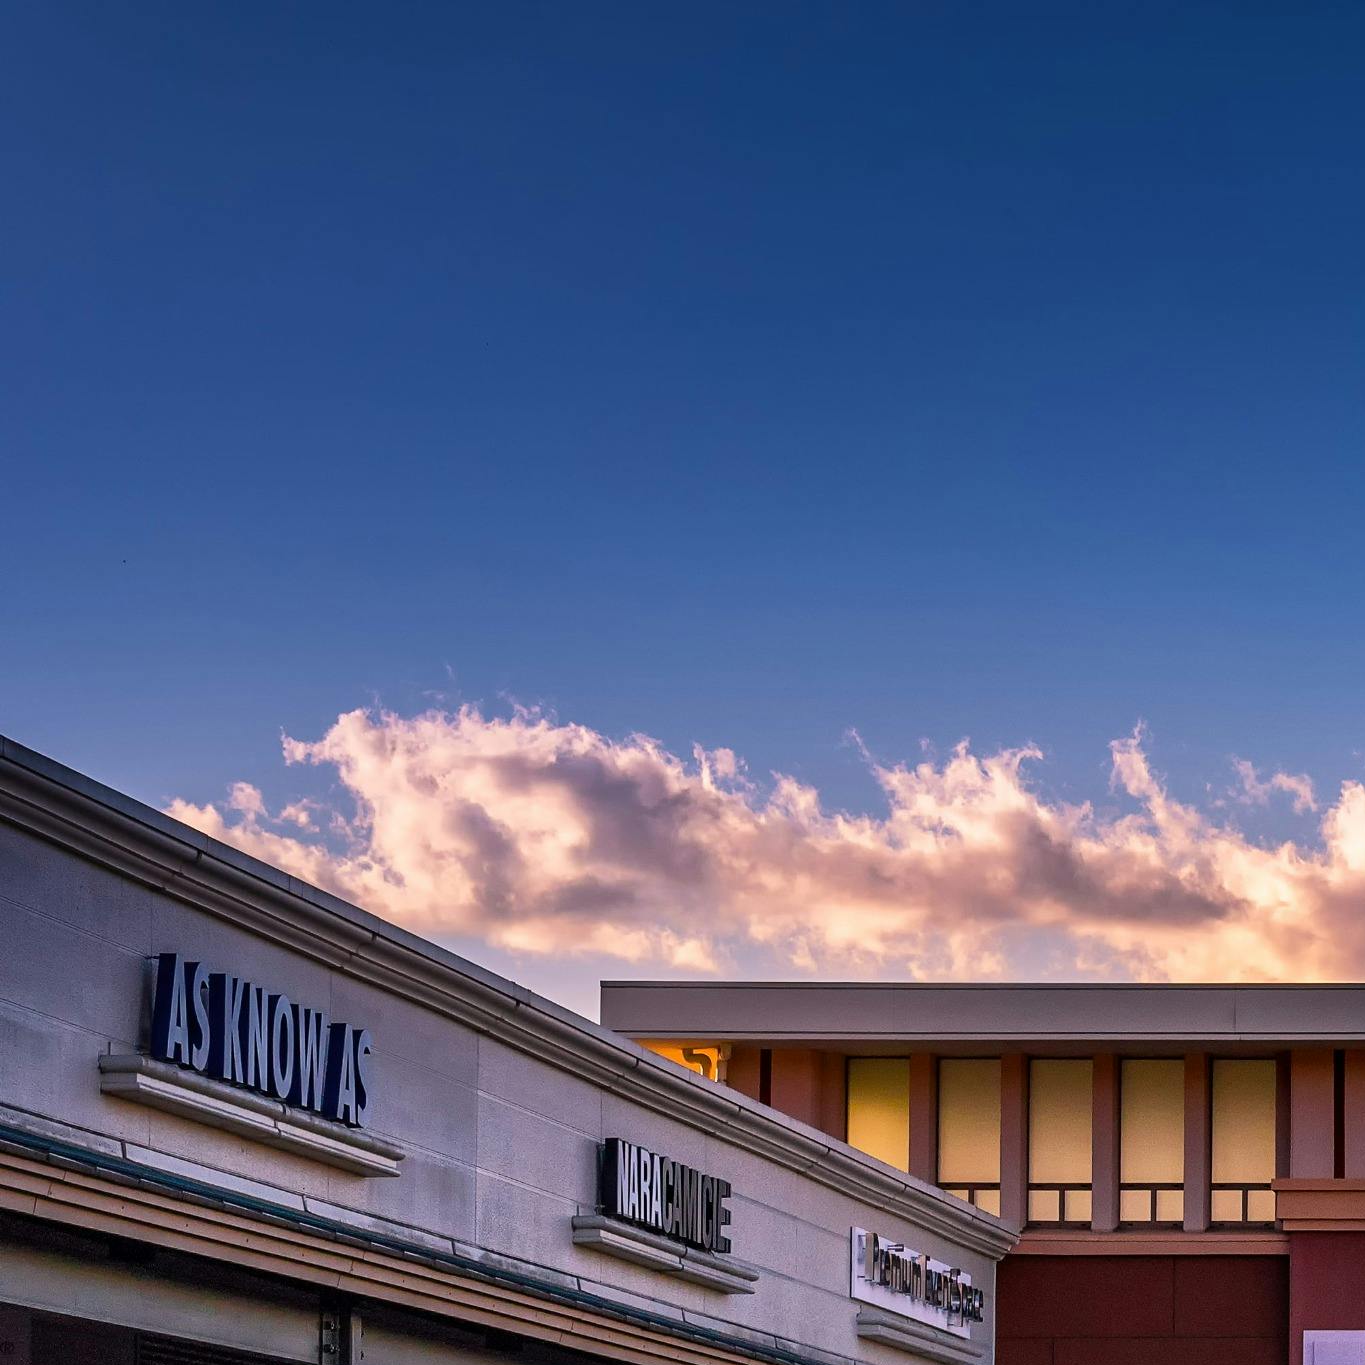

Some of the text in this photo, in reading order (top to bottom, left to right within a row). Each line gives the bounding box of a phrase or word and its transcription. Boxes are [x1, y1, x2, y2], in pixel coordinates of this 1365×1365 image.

[159, 953, 374, 1128] AS KNOW AS
